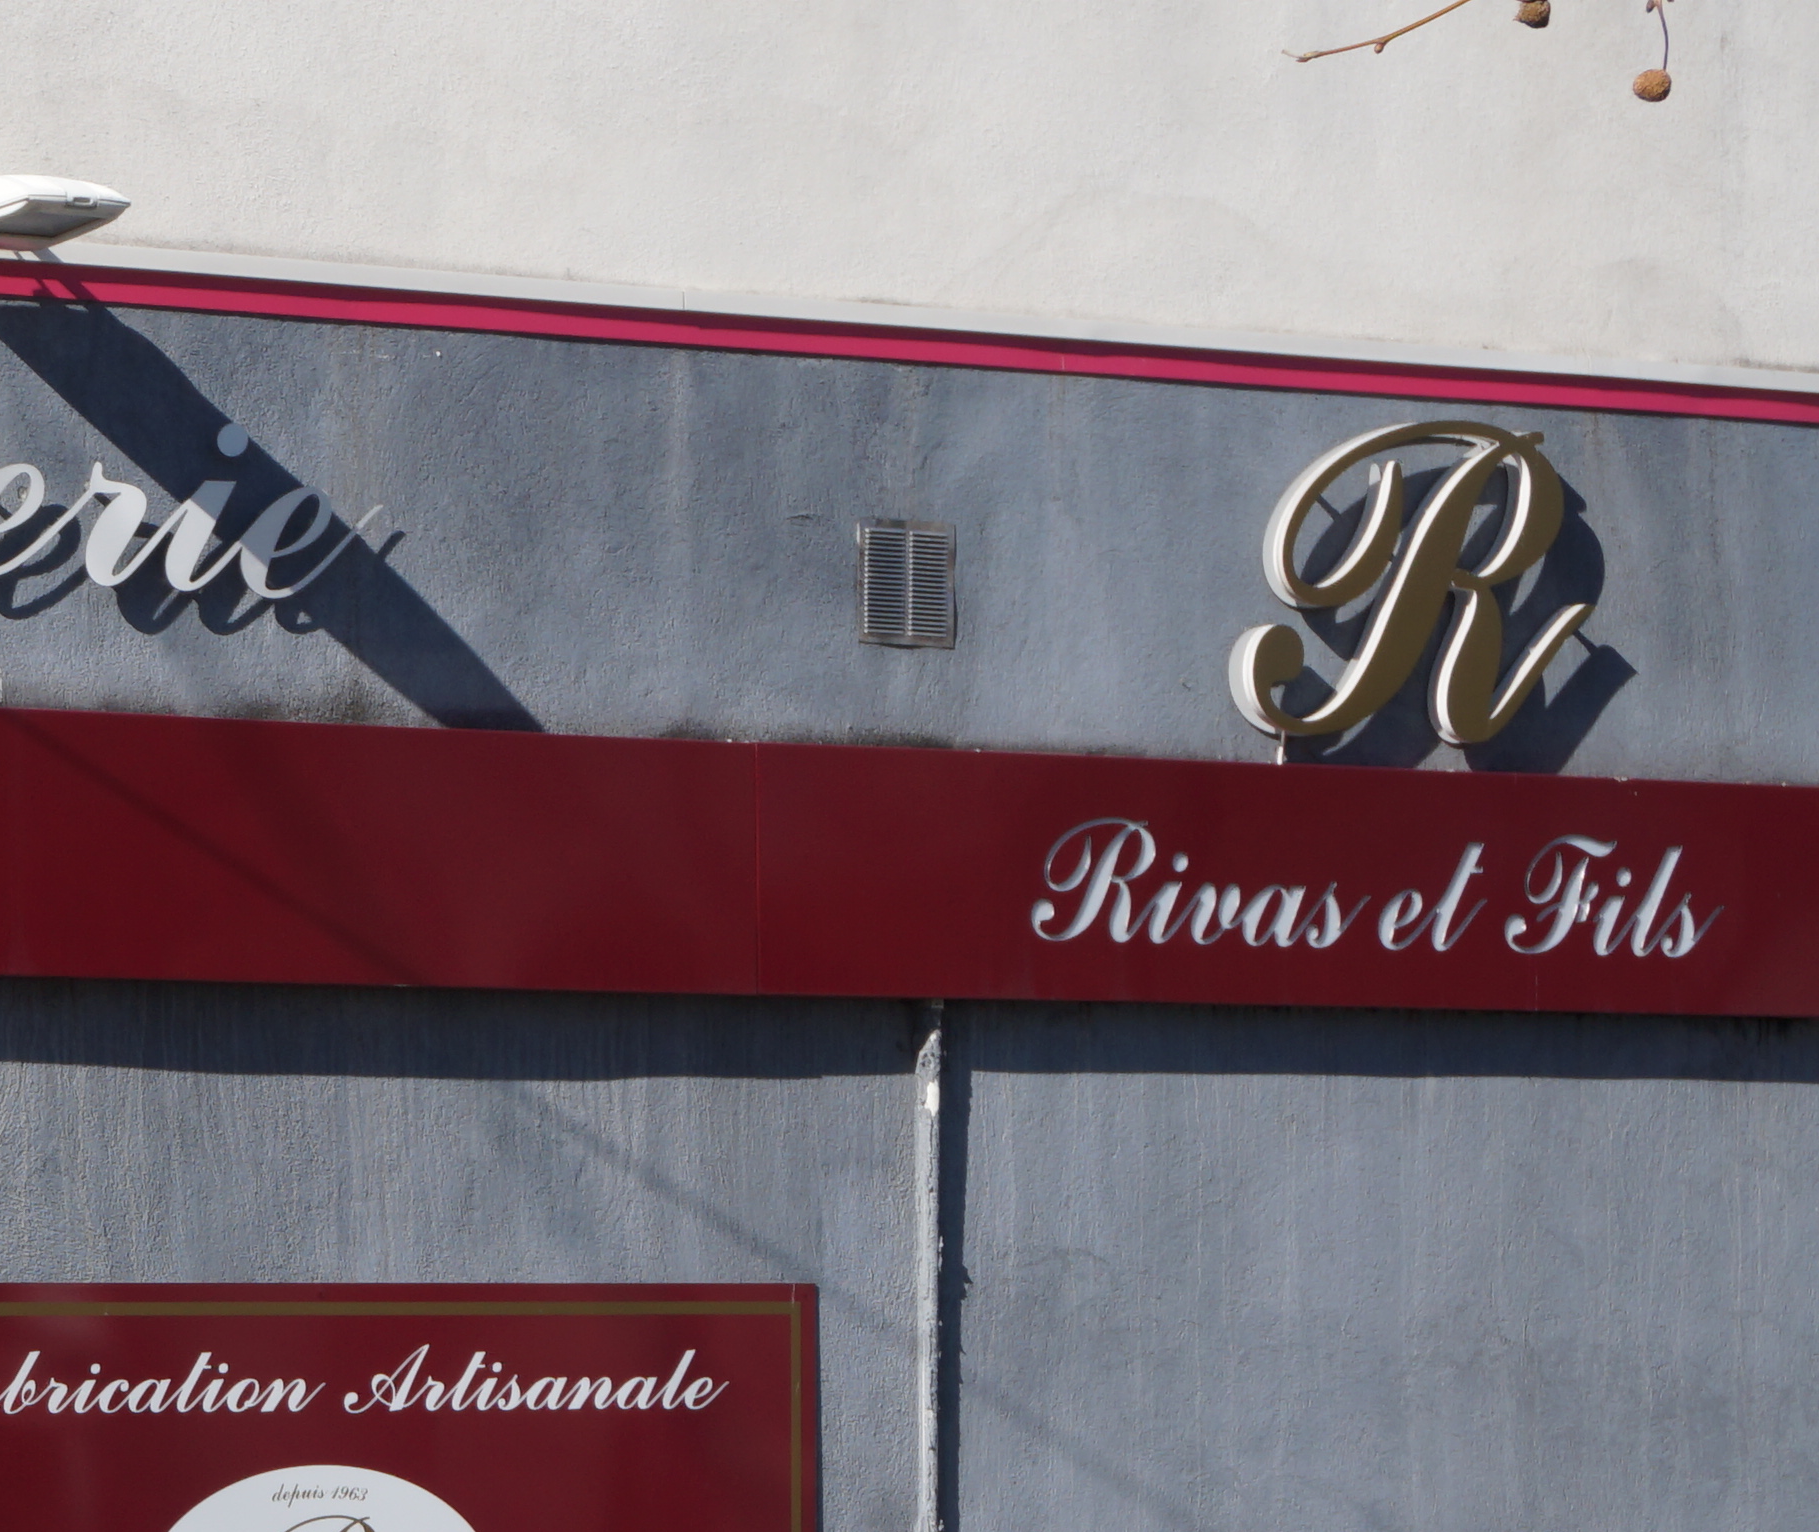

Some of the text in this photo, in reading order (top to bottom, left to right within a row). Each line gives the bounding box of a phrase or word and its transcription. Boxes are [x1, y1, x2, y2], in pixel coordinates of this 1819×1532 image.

[1228, 420, 1594, 746] R
[1031, 817, 1724, 957] Rivas et Fils
[343, 1343, 729, 1416] Artisanale
[271, 1483, 369, 1508] depuis 1963
